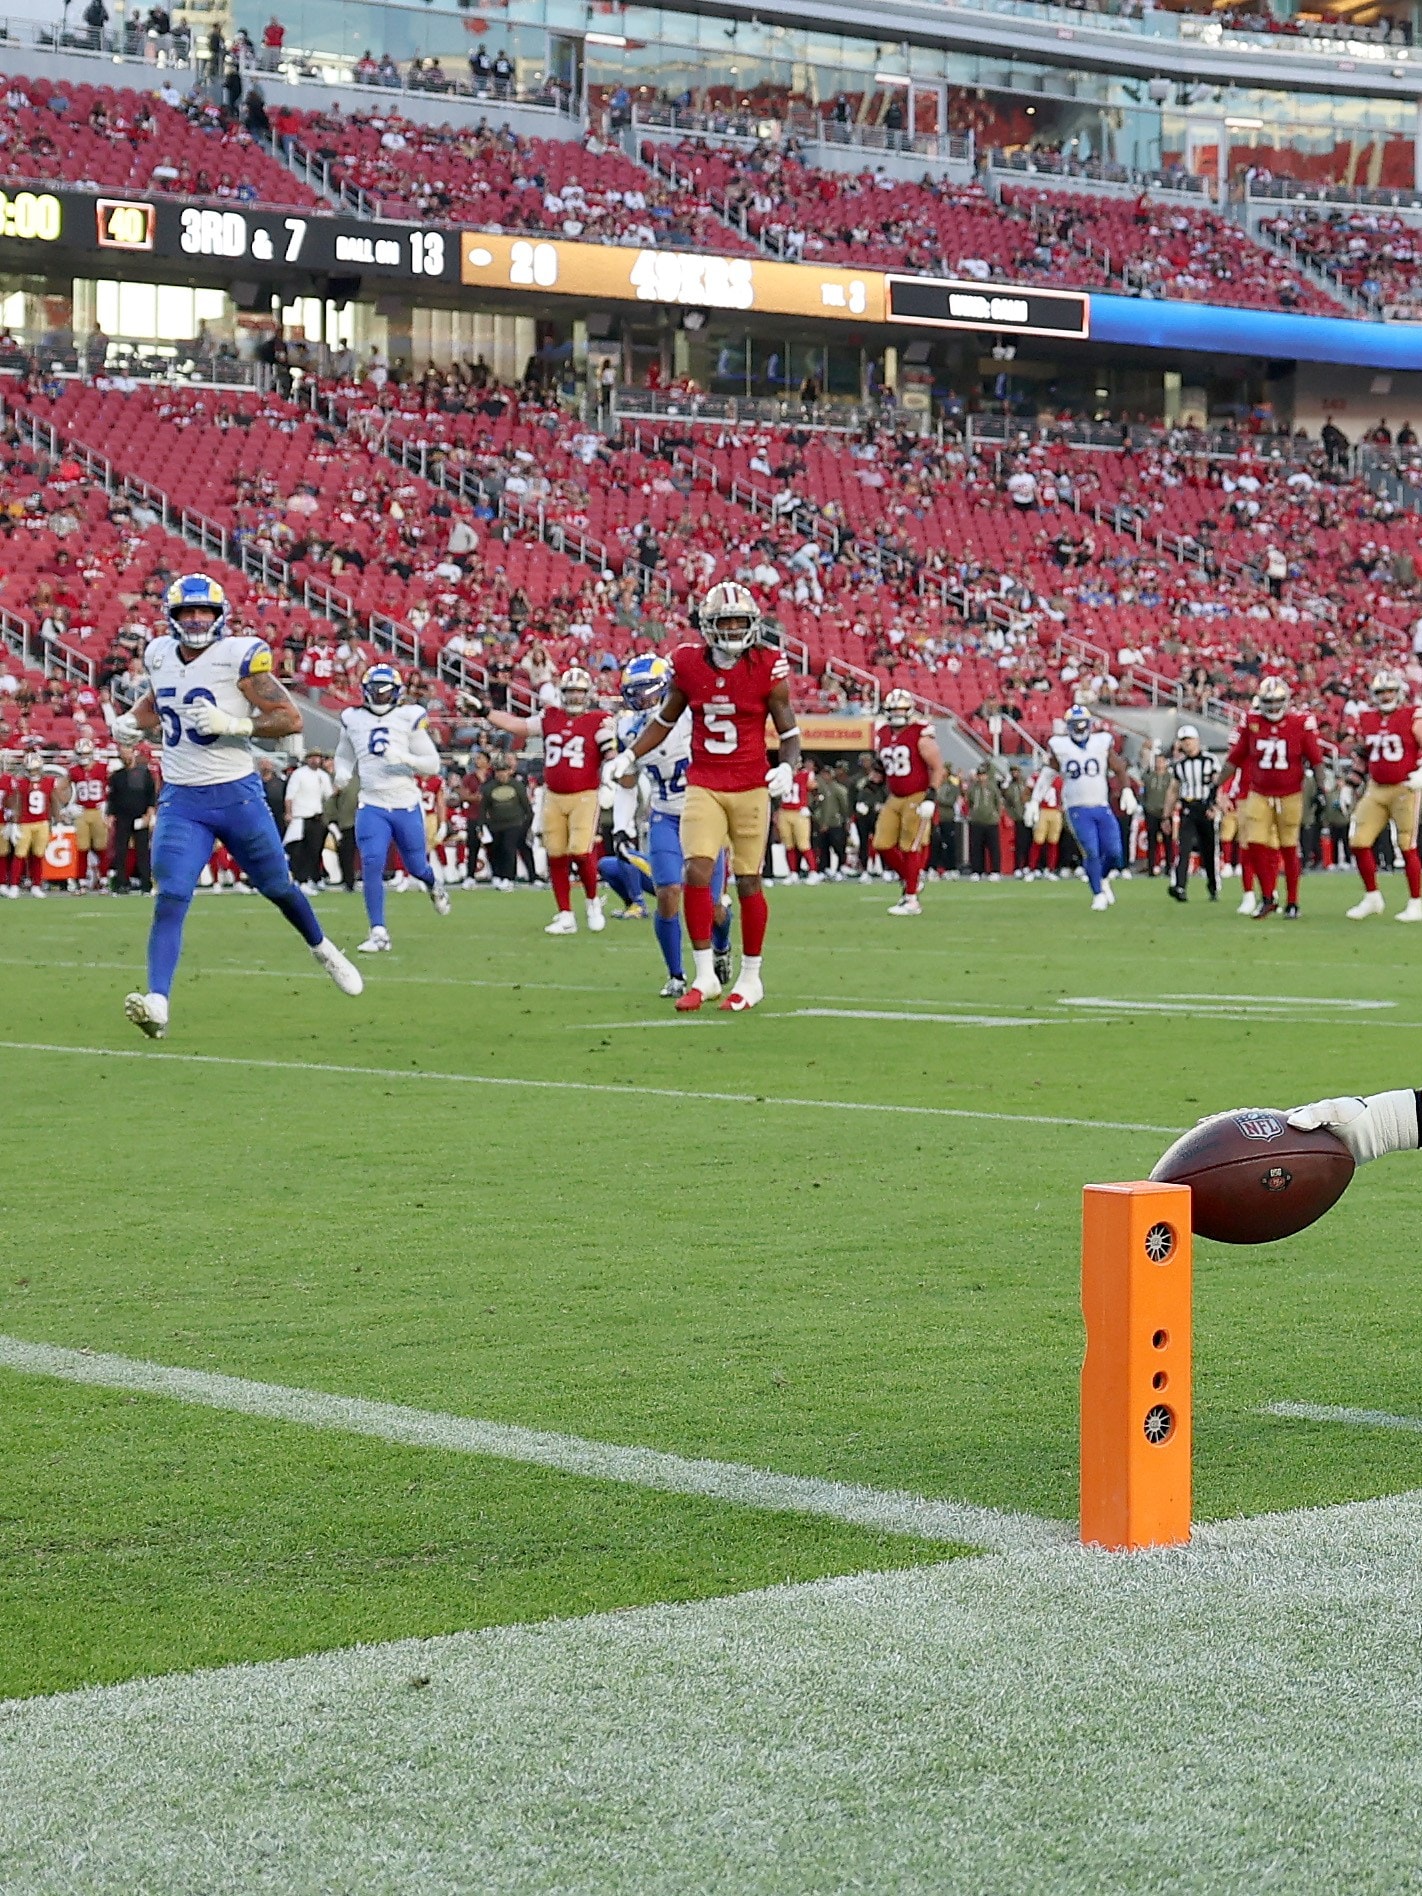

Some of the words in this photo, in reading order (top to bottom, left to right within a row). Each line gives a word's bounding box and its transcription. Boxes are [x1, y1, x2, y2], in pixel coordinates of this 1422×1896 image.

[108, 207, 145, 243] 40
[181, 208, 247, 257] 3RD
[251, 228, 274, 261] &
[284, 218, 306, 262] 7
[409, 231, 445, 276] 13
[509, 240, 558, 287] 20
[368, 726, 390, 758] 6
[702, 702, 738, 755] 5
[544, 732, 586, 769] 64
[879, 745, 912, 777] 68
[1256, 738, 1290, 770] 71
[1365, 733, 1405, 762] 70
[1066, 758, 1099, 780] 90
[28, 790, 45, 815] 9
[44, 838, 71, 868] G
[1242, 1118, 1280, 1136] NFL
